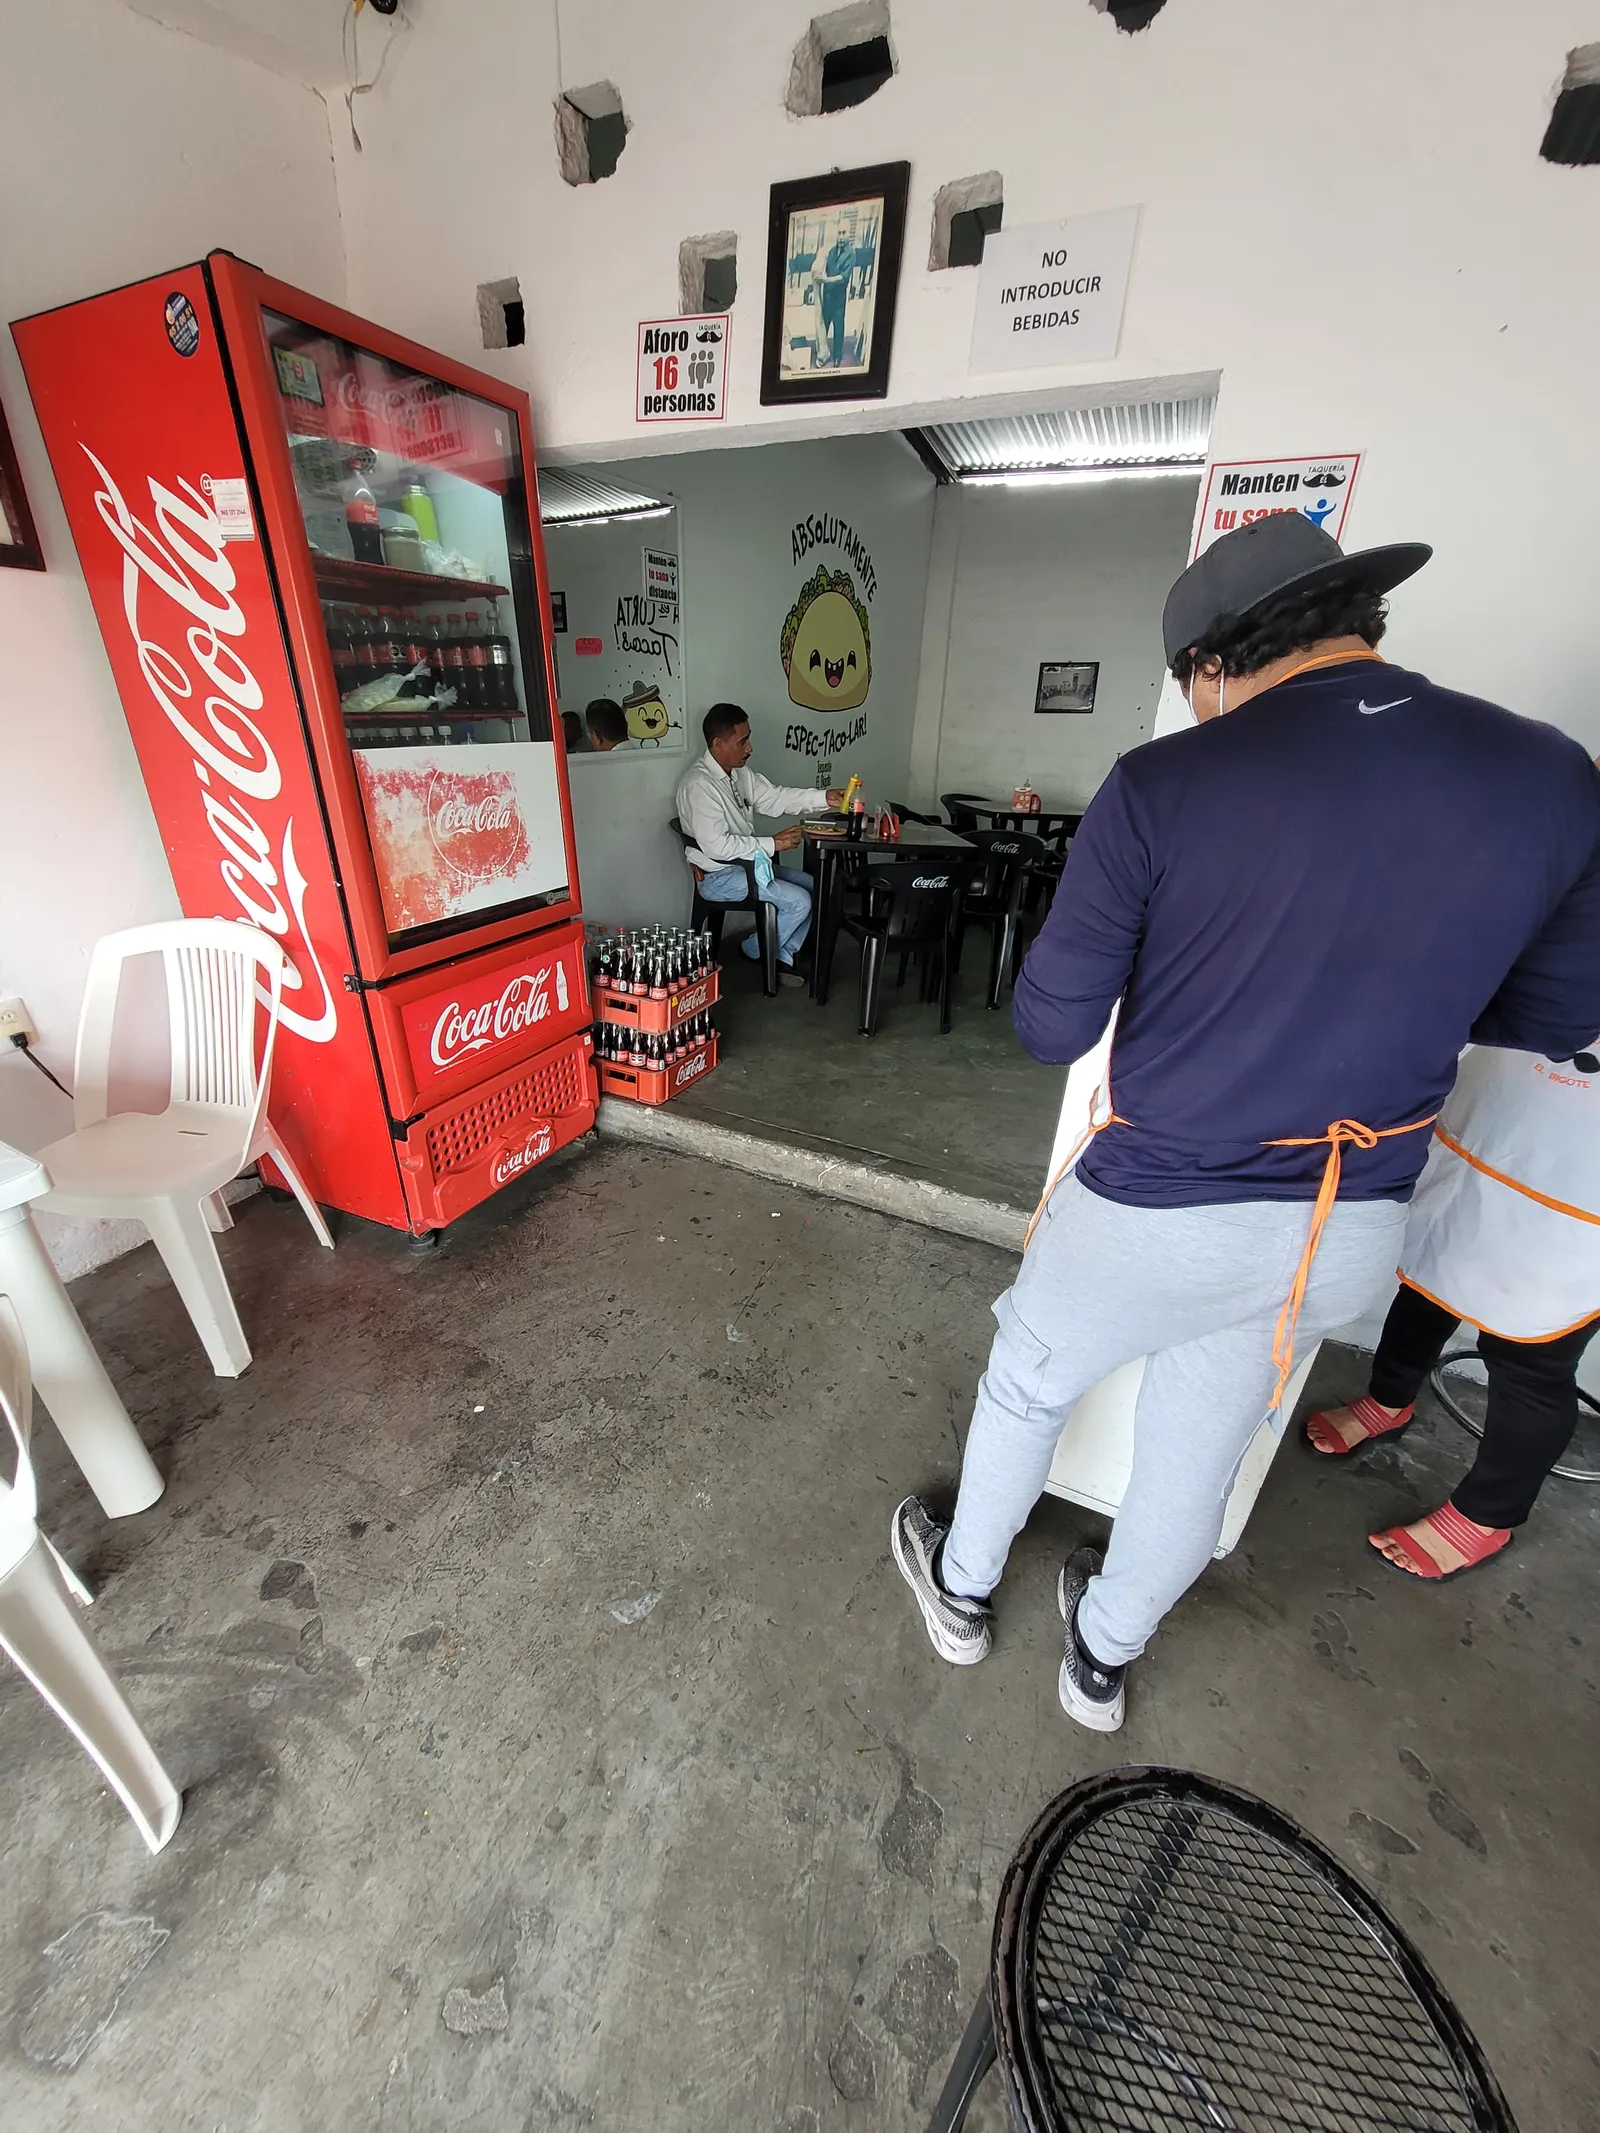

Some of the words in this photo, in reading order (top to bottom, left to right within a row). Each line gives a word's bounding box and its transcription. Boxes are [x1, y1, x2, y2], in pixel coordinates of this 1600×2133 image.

[1041, 249, 1067, 269] NO
[1000, 276, 1102, 304] INTRODUCIR
[1012, 308, 1080, 332] BEBIDAS
[643, 328, 689, 354] Aforo
[652, 355, 679, 390] 16
[643, 393, 716, 416] personas
[1308, 462, 1346, 474] TAQUERÍA
[1220, 473, 1300, 496] Manten
[1213, 508, 1237, 530] tu
[791, 512, 878, 603] ABSOLUTAMENTE
[656, 571, 669, 583] sana
[648, 585, 677, 602] distancia
[785, 712, 867, 757] ESPEC-TACO-LAR!
[1549, 1072, 1590, 1088] BIGOTE
